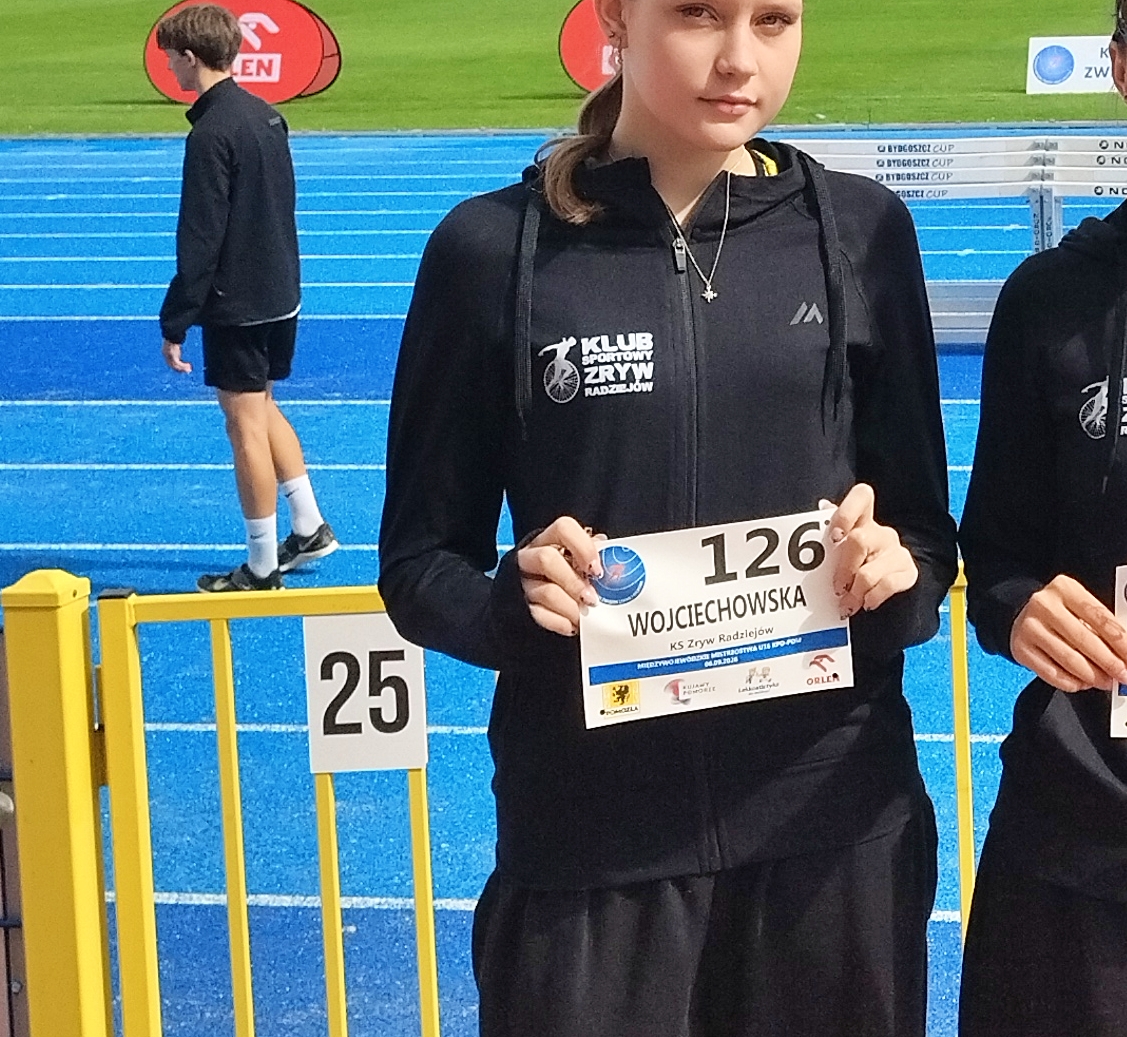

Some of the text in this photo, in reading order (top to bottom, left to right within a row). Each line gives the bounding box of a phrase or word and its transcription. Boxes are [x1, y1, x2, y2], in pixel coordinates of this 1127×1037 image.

[888, 144, 955, 153] BYDGOSZCZ CUP
[887, 158, 954, 168] BYDGOSZCZ CUP
[885, 172, 953, 181] BYDGOSZCZ CUP
[926, 190, 948, 198] CUP
[581, 332, 654, 355] KLUB
[582, 350, 654, 366] SPORTOWY
[583, 362, 655, 384] ZRYW
[584, 379, 654, 397] RADZIEJÓW
[700, 520, 827, 586] 126
[627, 584, 808, 637] WOJCIECHOWSKA
[670, 627, 775, 652] KS Zryw Radziejów
[320, 649, 410, 736] 25
